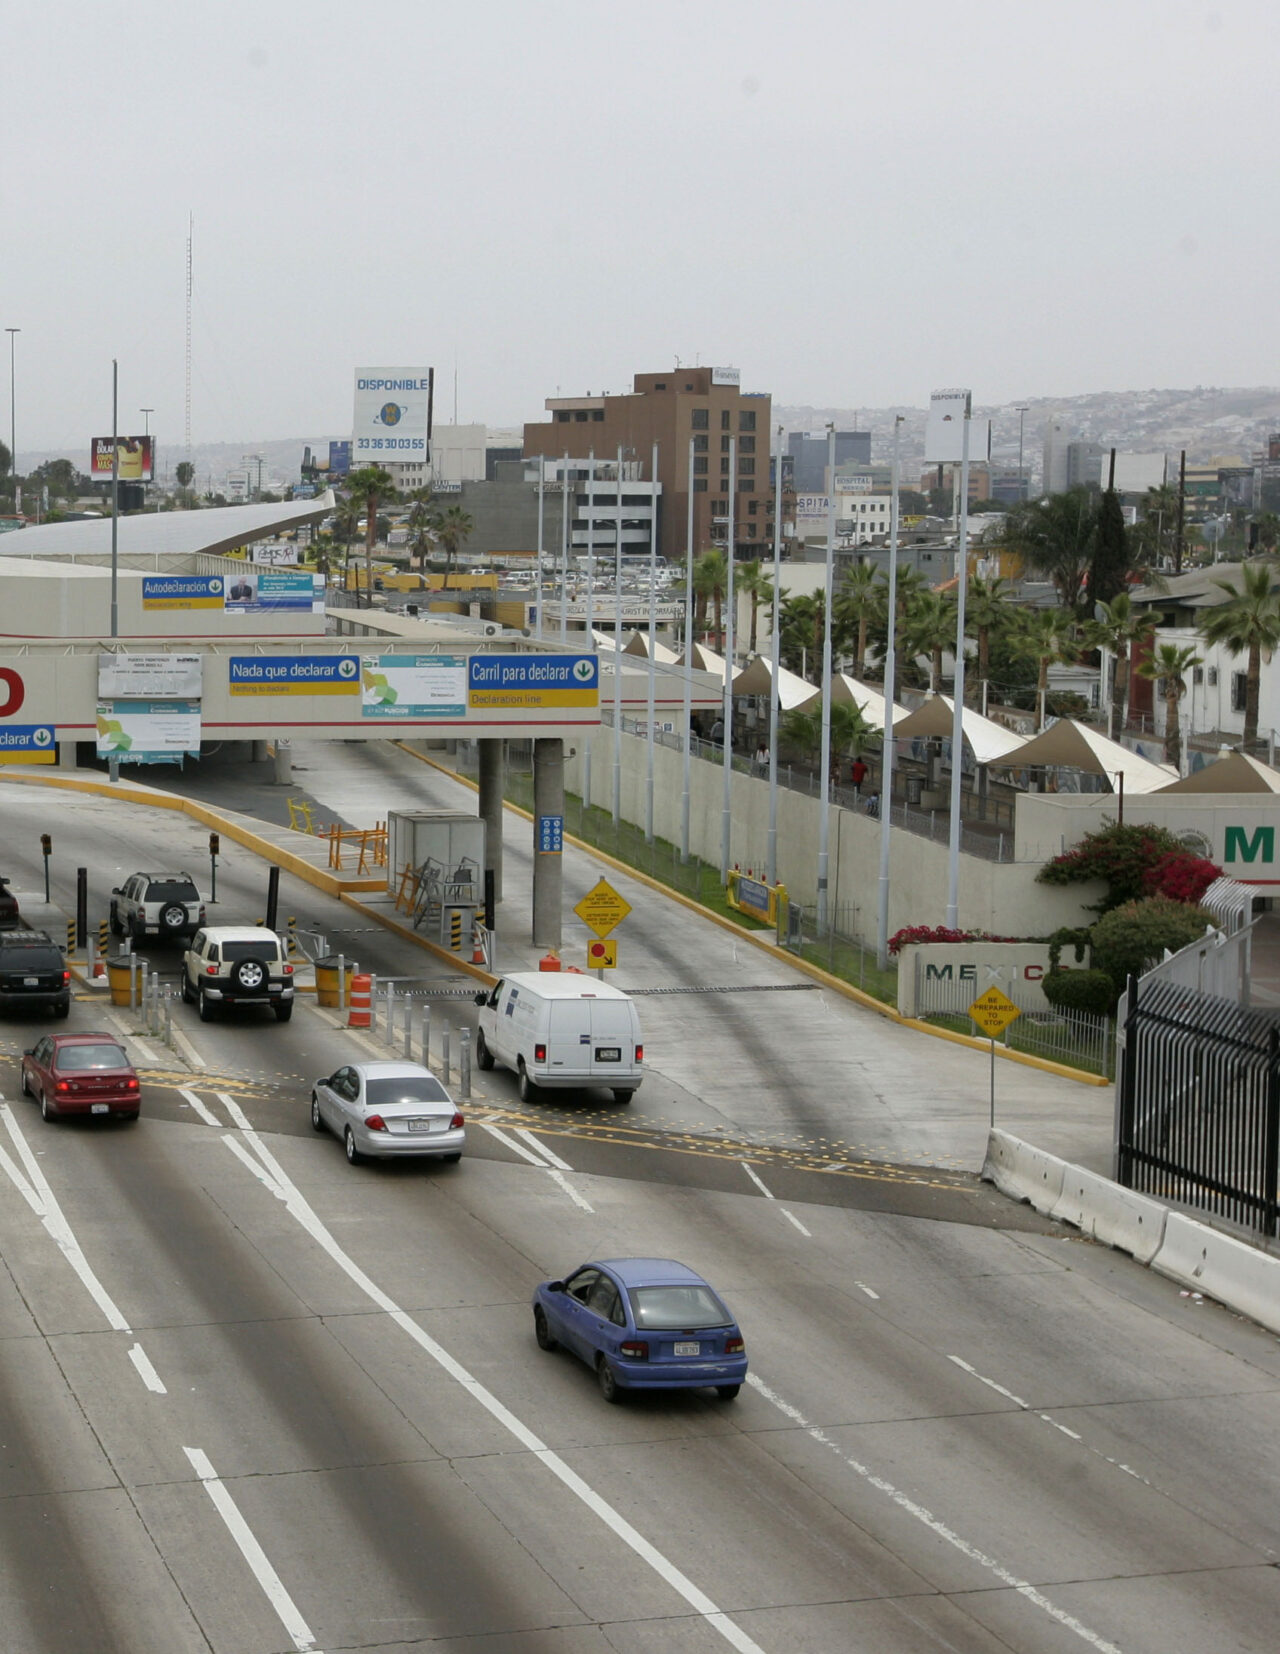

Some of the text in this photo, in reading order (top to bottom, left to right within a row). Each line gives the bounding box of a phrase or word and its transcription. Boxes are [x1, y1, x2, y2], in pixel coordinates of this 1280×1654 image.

[357, 379, 428, 391] DISPONIBLE
[358, 438, 370, 449] 33
[836, 476, 871, 485] HOSPITAL
[144, 579, 207, 594] Autodeclaración
[621, 607, 686, 615] URIST INORMATIO
[232, 663, 336, 679] Nada que declarar
[472, 662, 570, 685] Carril para declarar
[472, 694, 541, 704] Declaration line
[1224, 826, 1275, 863] M
